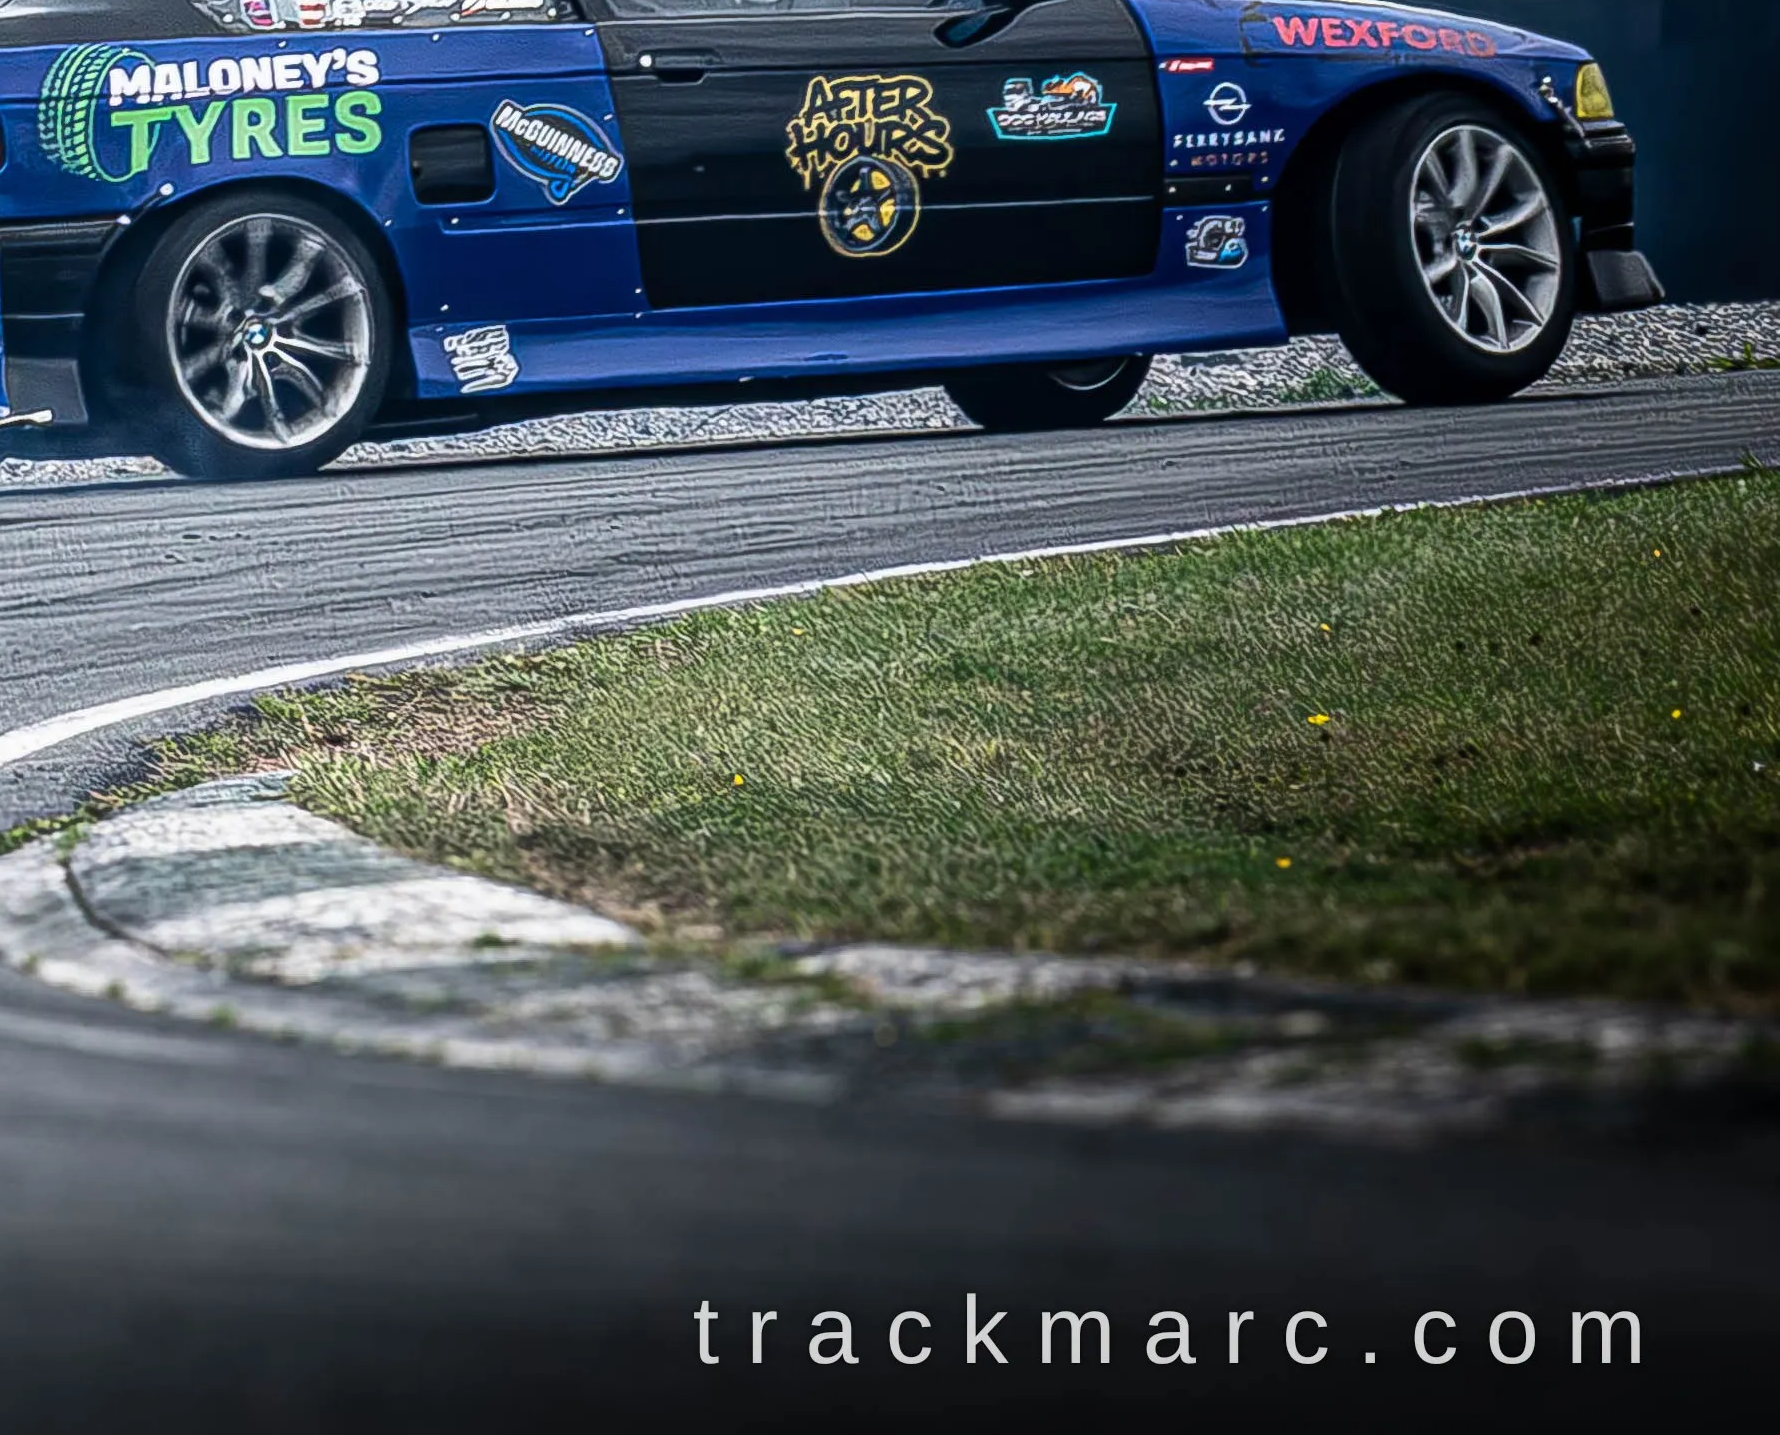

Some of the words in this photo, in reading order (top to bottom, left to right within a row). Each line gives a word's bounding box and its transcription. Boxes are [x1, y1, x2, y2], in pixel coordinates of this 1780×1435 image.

[1272, 16, 1497, 58] WEXFORD
[108, 48, 380, 106] MALONEY'S
[110, 90, 382, 172] TYRES
